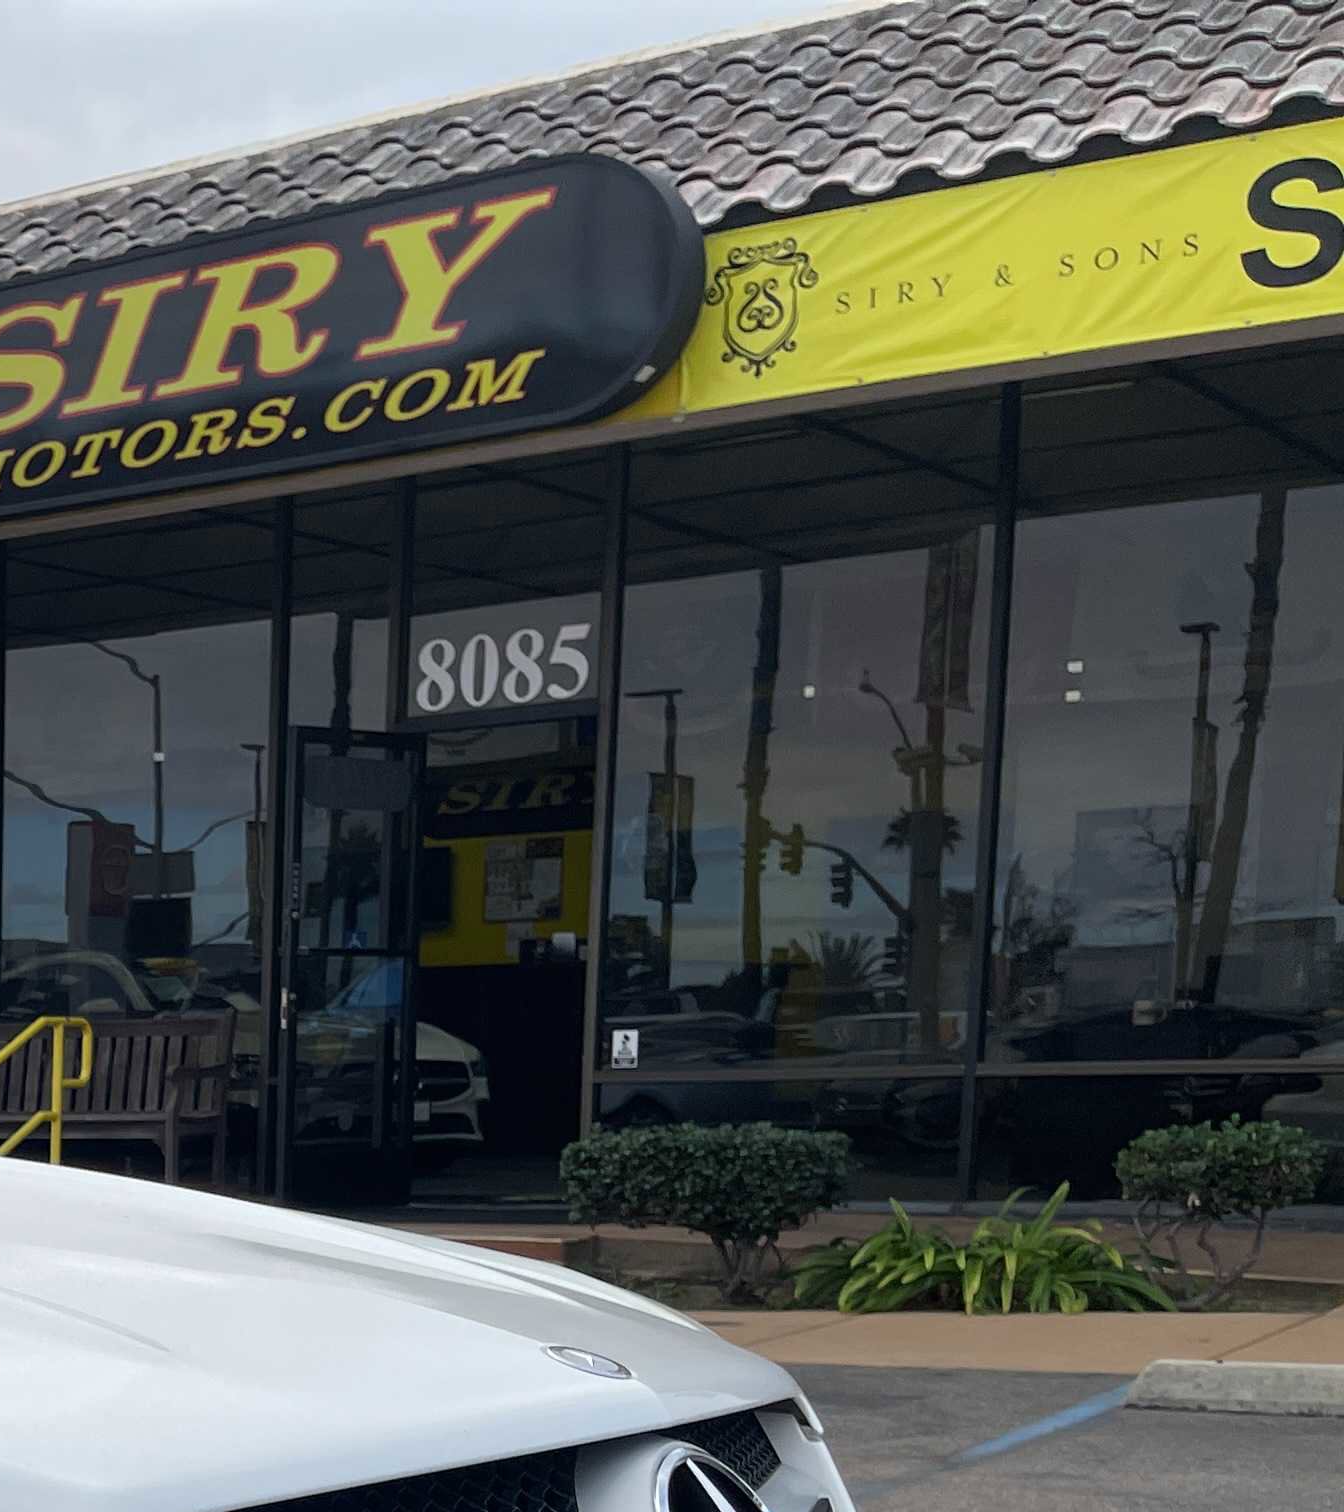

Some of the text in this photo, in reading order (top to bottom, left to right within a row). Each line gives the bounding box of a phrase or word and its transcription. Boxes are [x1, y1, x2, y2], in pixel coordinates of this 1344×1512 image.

[836, 275, 953, 314] SIRY
[995, 264, 1016, 287] &
[1059, 233, 1201, 278] SONS
[416, 623, 591, 712] 8085
[437, 770, 593, 815] SIR
